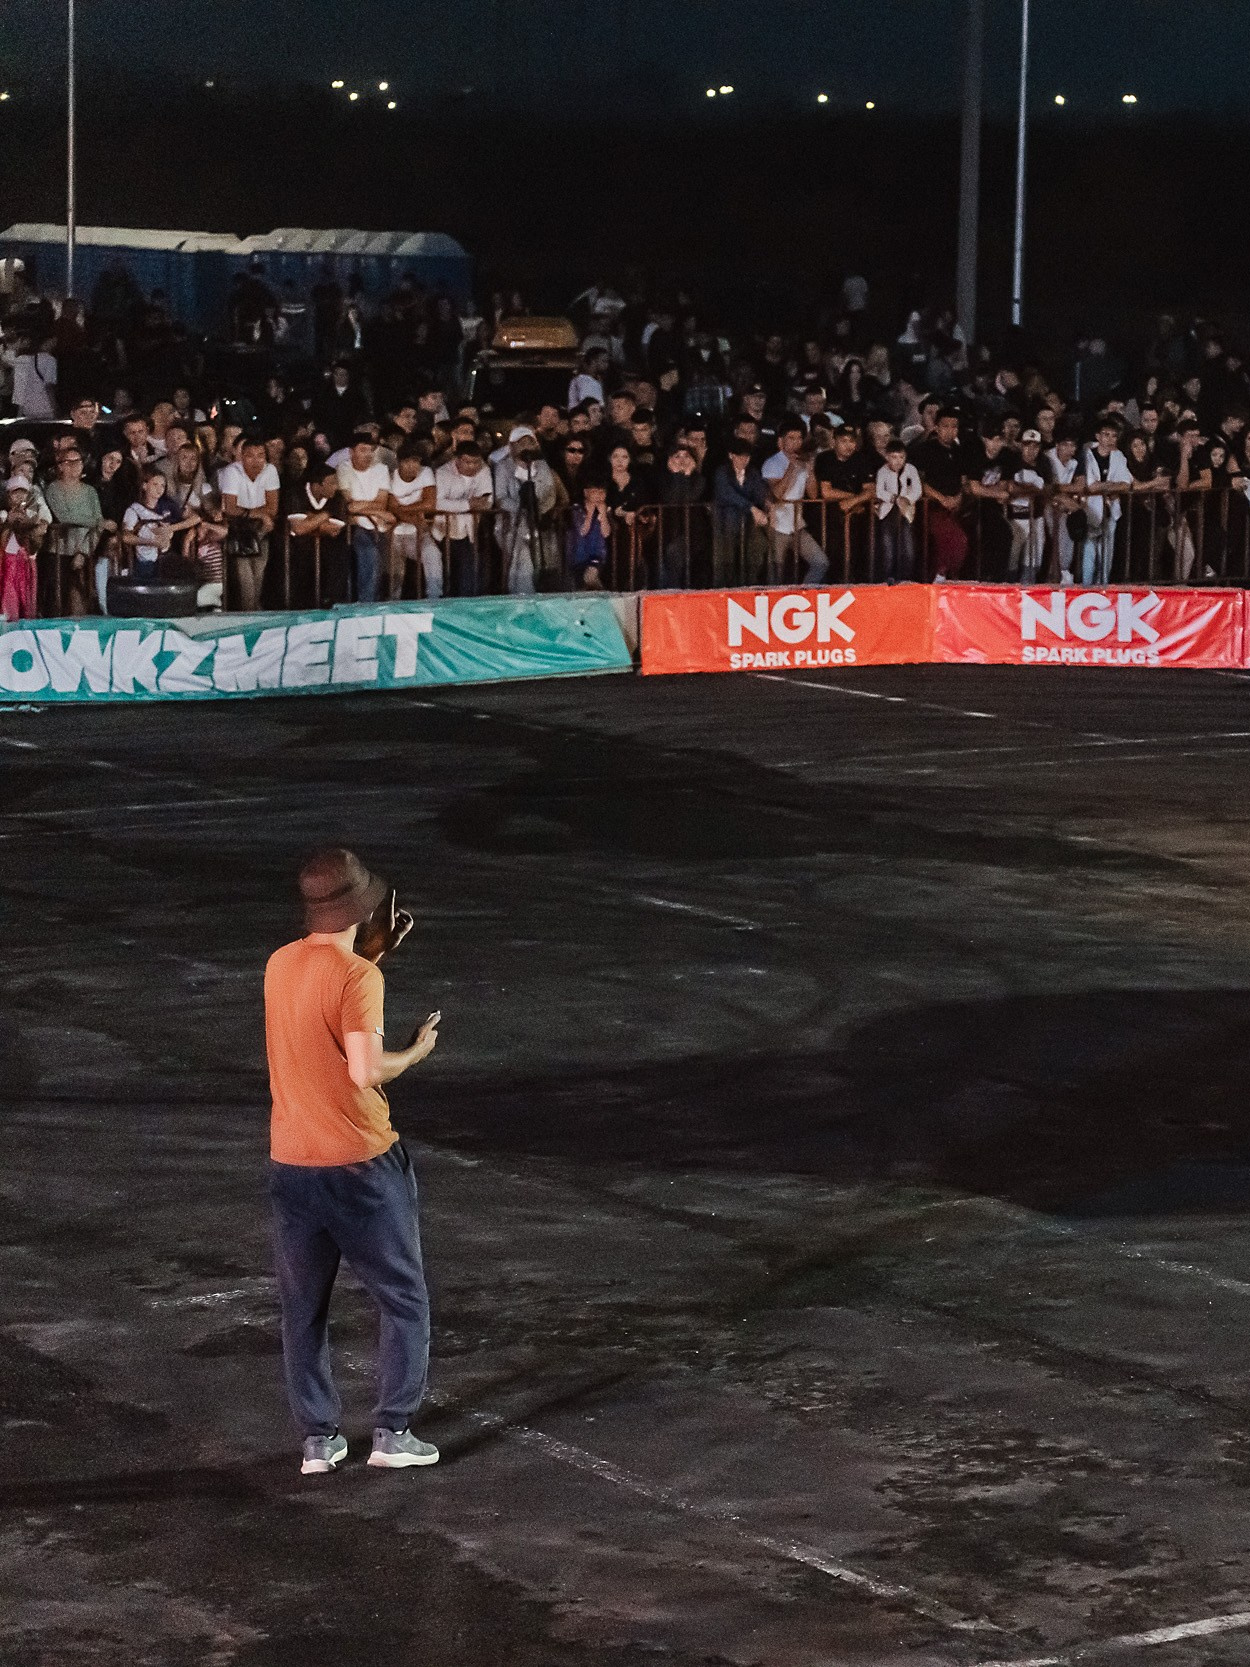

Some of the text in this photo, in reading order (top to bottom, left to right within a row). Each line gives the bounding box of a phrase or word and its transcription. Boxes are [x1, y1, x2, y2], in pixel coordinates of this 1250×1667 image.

[728, 591, 856, 647] NGK
[1021, 591, 1161, 643] NGK
[0, 613, 434, 693] OWKZMEET
[730, 648, 857, 669] SPARK PLUGS
[1022, 646, 1160, 665] SPARK PLUGS
